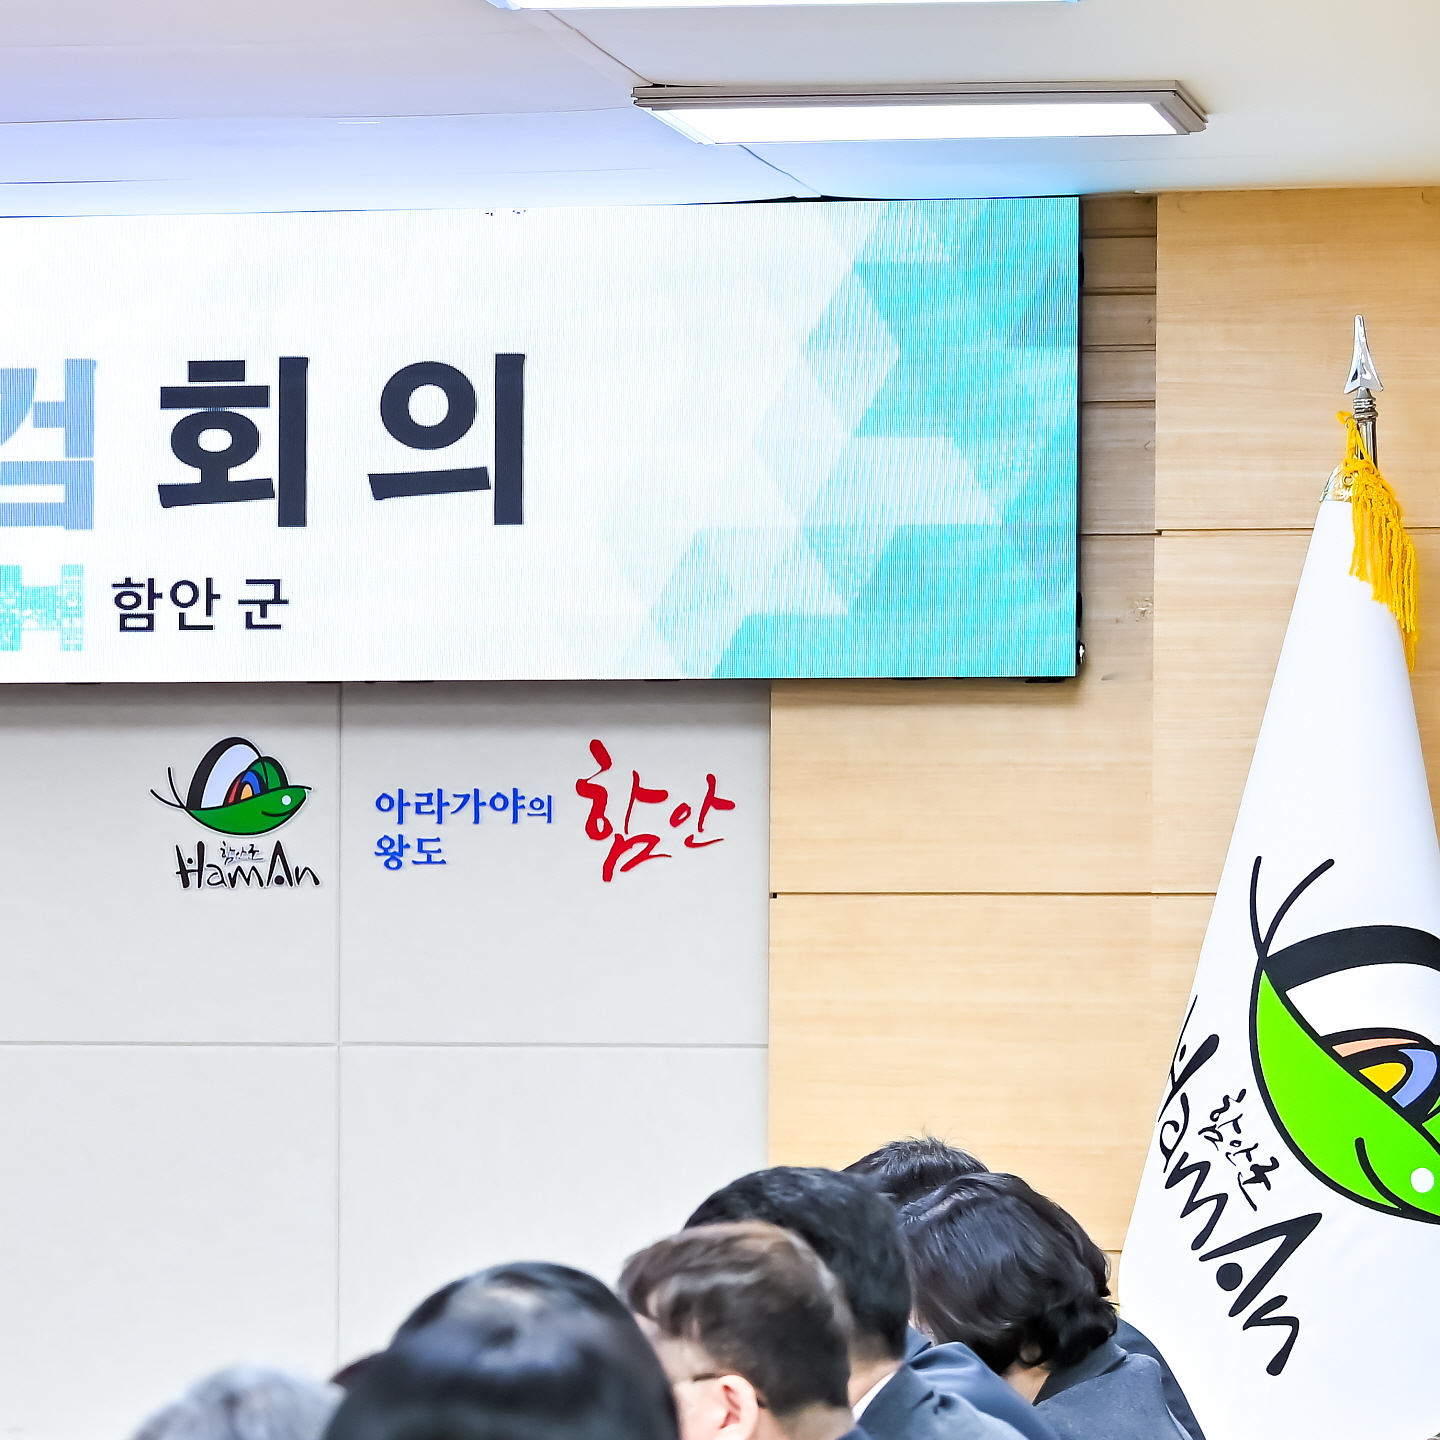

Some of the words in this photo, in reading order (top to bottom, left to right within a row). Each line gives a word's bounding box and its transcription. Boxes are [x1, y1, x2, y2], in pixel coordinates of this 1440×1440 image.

[374, 787, 553, 825] 아라가야의
[575, 739, 737, 883] 함안
[175, 840, 320, 888] HamAn
[373, 833, 448, 871] 왕도
